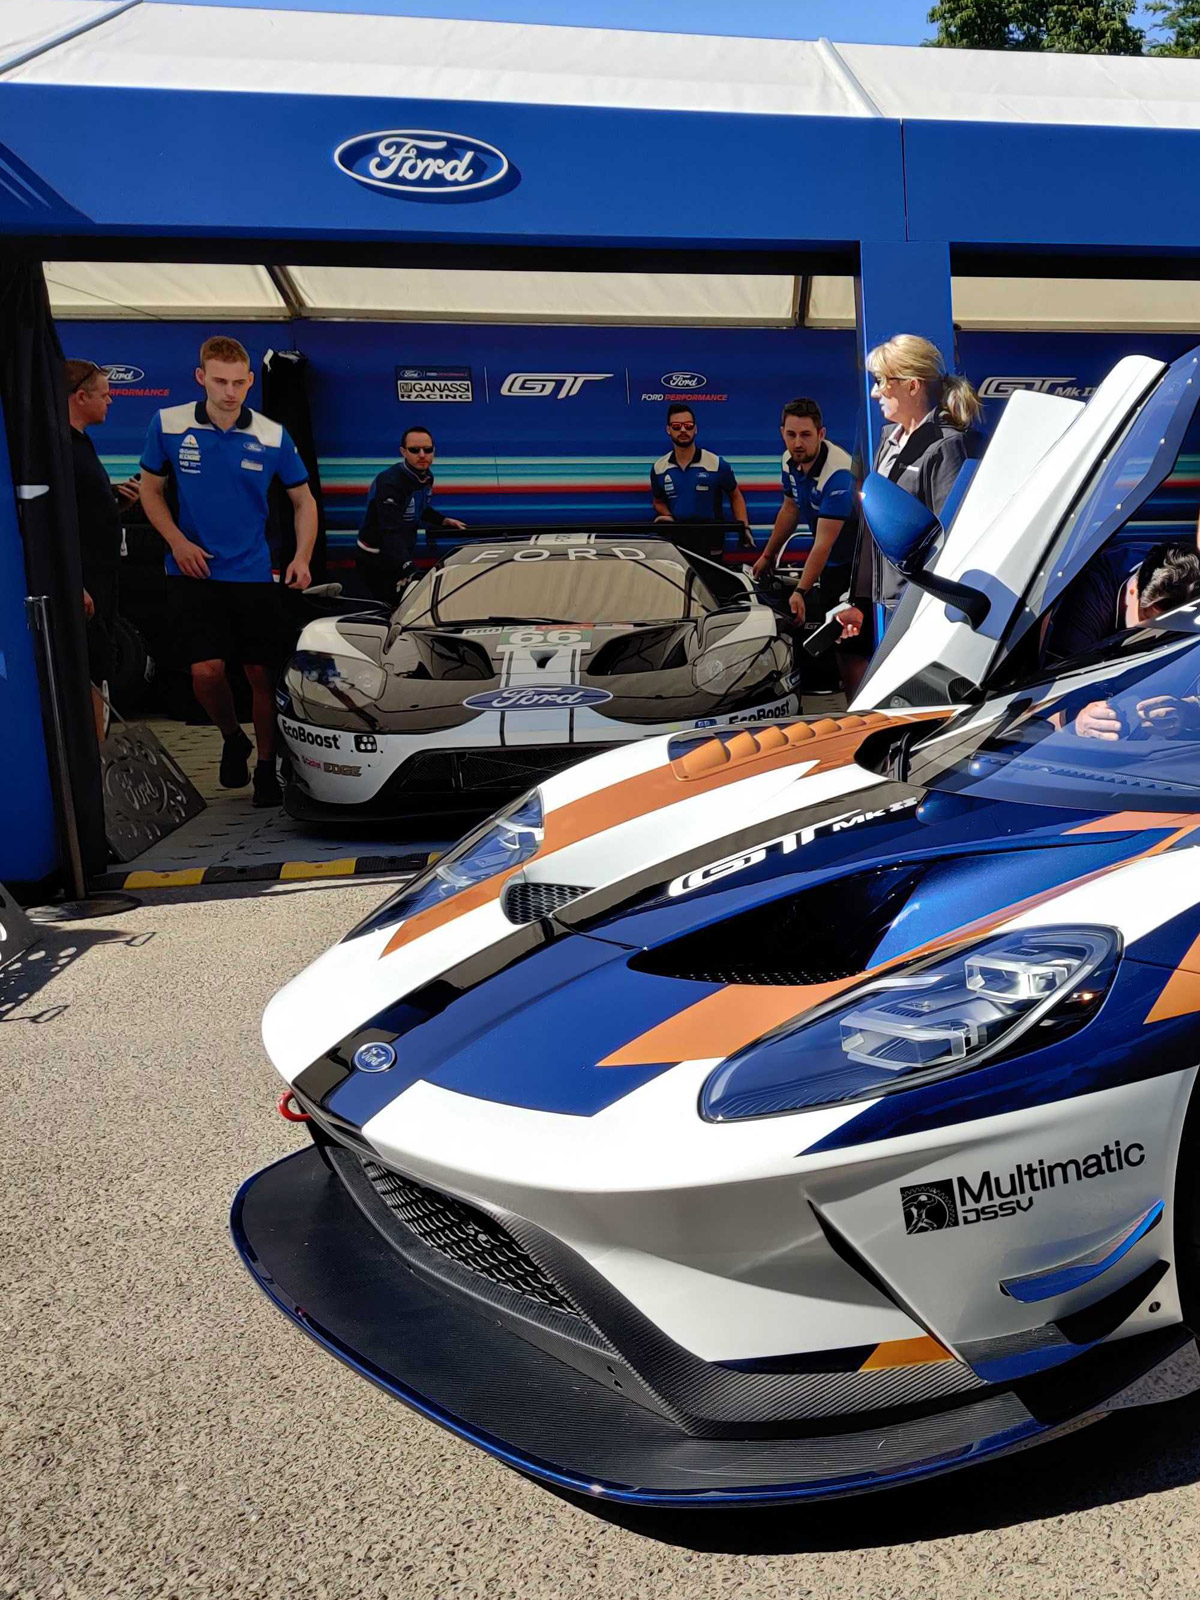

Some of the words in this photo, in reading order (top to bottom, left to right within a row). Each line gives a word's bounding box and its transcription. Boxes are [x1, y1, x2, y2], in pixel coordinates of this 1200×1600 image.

[368, 137, 475, 182] Ford
[413, 382, 470, 393] GANASSI
[500, 373, 614, 399] GT
[669, 374, 698, 387] Ford
[978, 376, 1077, 398] GT
[1054, 386, 1082, 397] Mk
[109, 388, 170, 396] RFORMANCE
[641, 393, 664, 401] FORD
[665, 393, 728, 401] PERFORMANCE
[470, 547, 647, 563] FORD
[508, 629, 583, 645] 66
[491, 687, 584, 708] Ford
[282, 719, 341, 750] EcoBoost
[323, 761, 362, 777] EDGE
[668, 808, 863, 897] GT
[832, 808, 887, 832] Mk
[957, 1140, 1145, 1207] Multimatic
[962, 1196, 1034, 1225] DSSV
